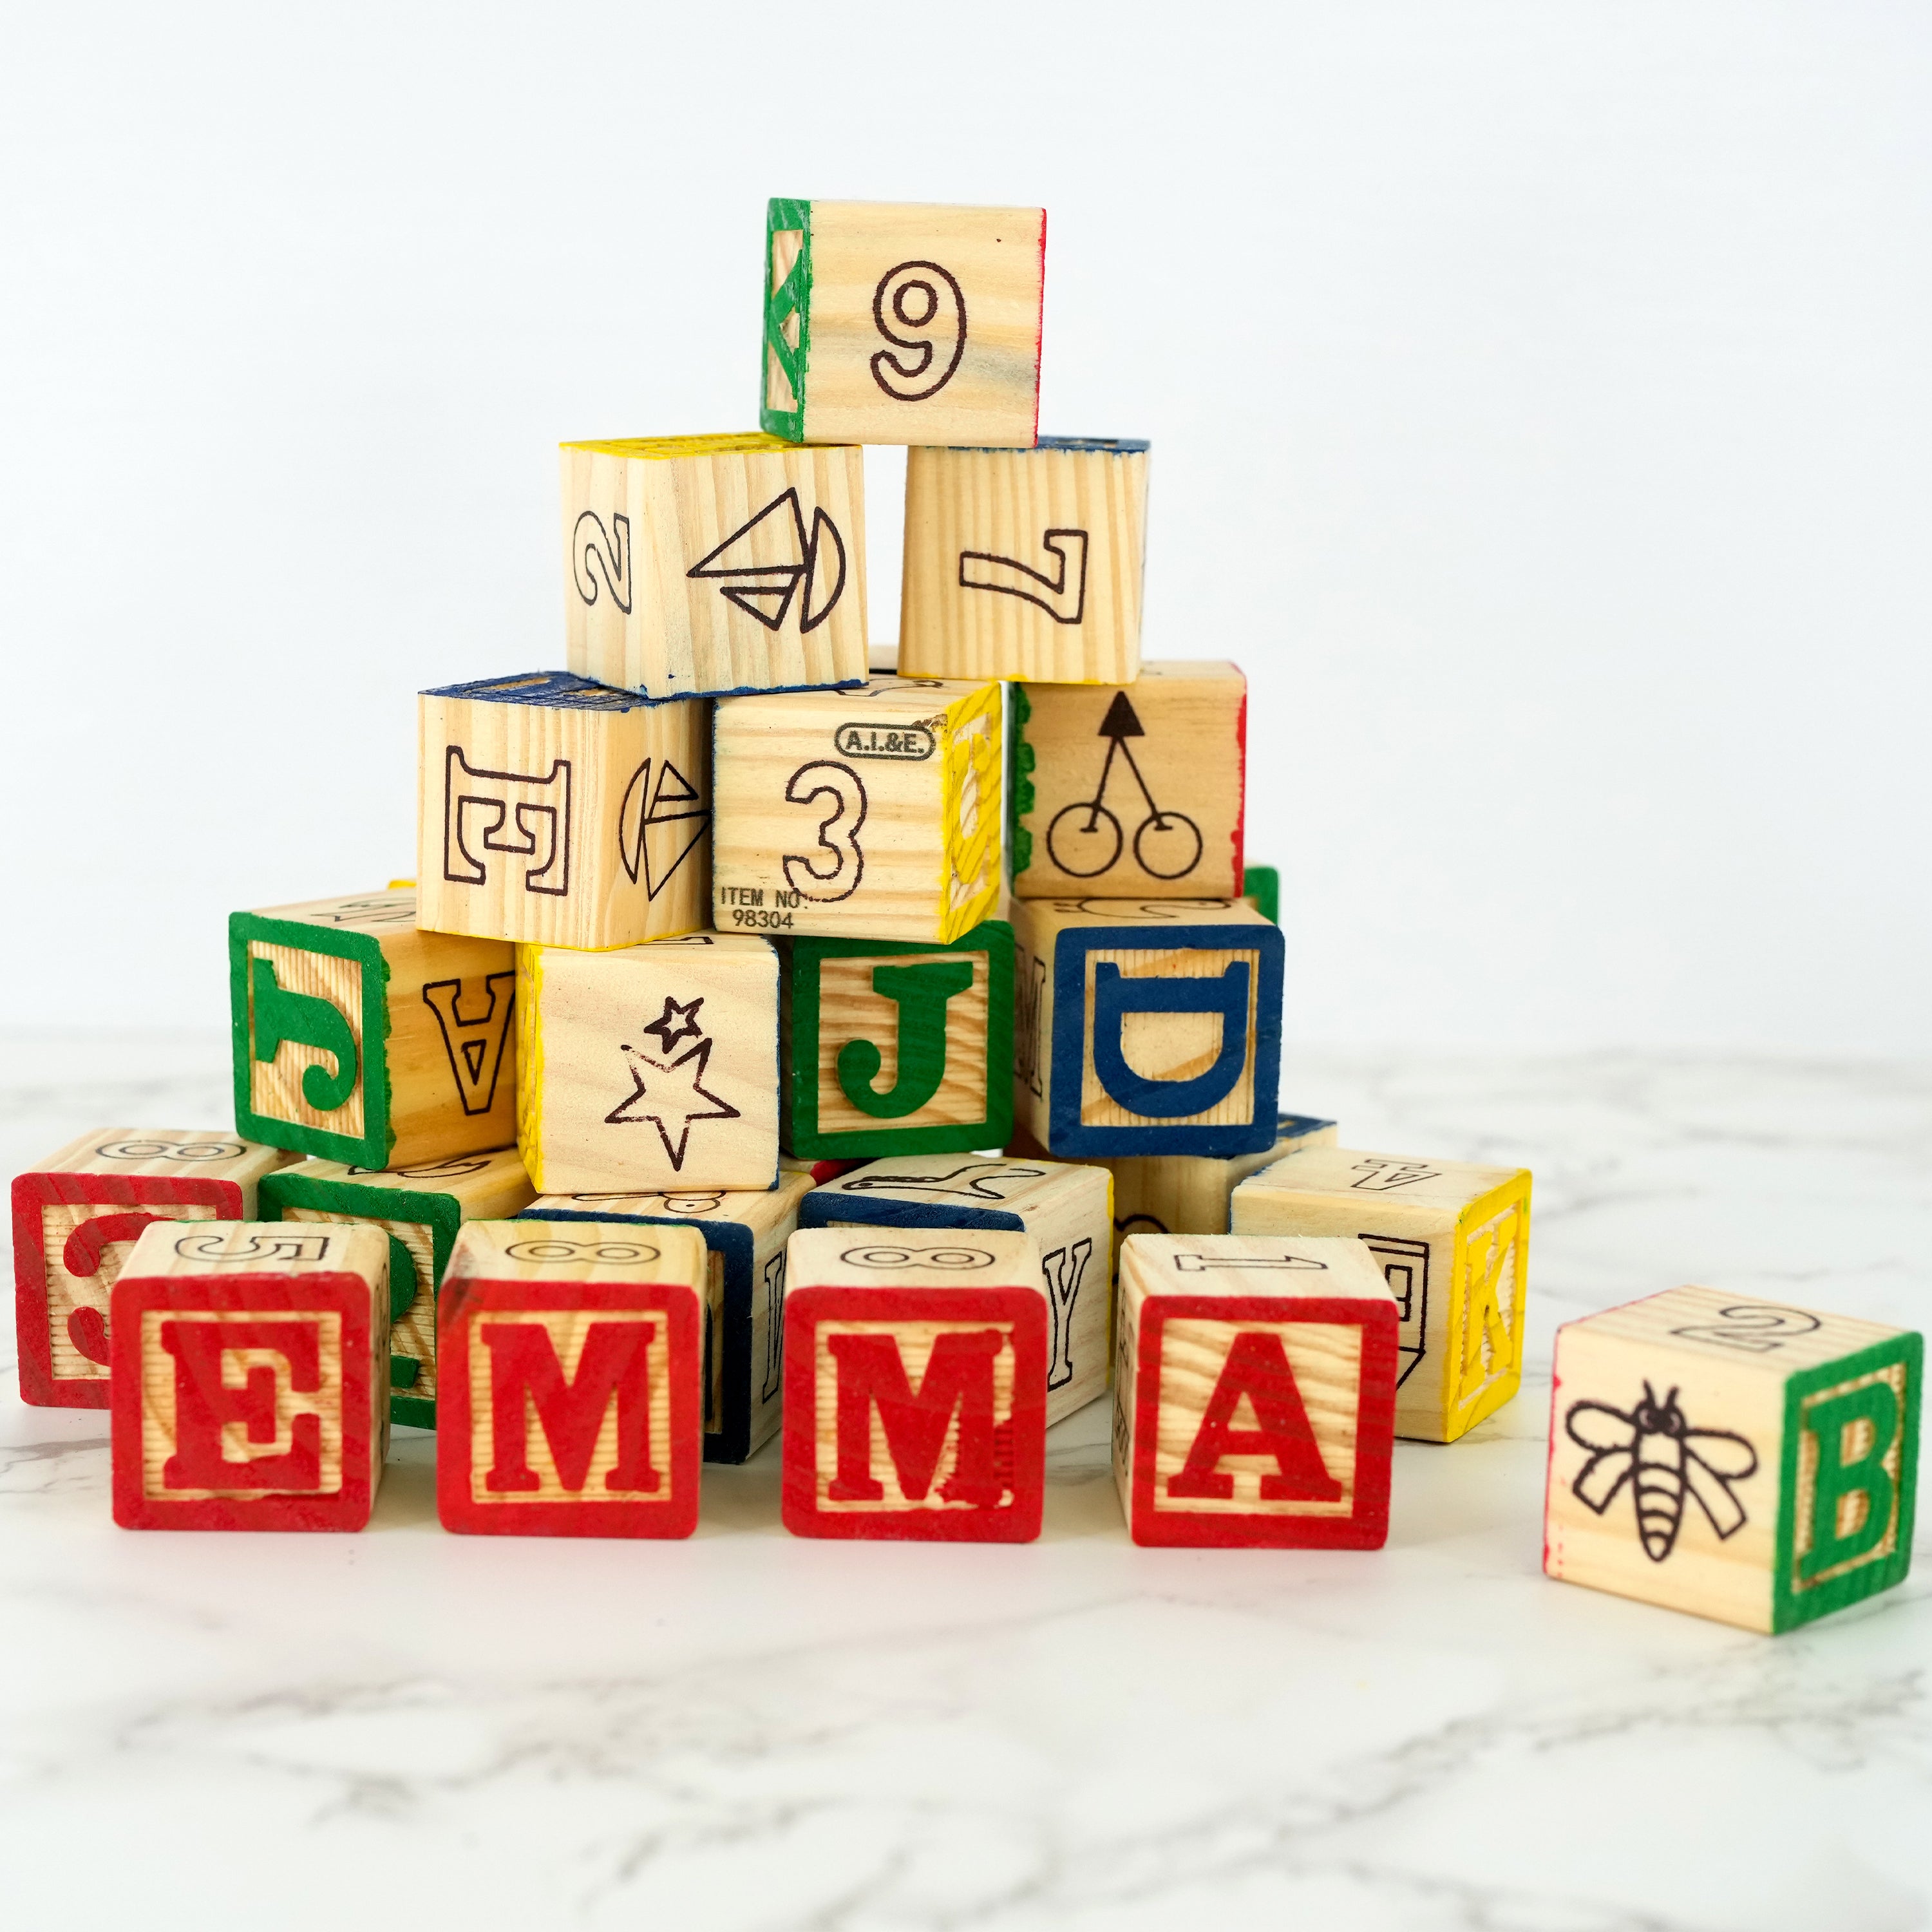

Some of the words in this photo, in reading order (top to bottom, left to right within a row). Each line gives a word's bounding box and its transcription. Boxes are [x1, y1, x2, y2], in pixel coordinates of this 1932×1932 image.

[871, 260, 966, 401] 9
[573, 511, 632, 614] 2
[960, 529, 1088, 624] 7
[846, 730, 925, 754] A.I.&E.
[444, 745, 571, 897] E
[783, 760, 867, 903] 3
[721, 887, 764, 907] ITEM
[733, 909, 793, 929] 98304
[254, 958, 357, 1111] J
[422, 970, 517, 1115] A
[837, 961, 973, 1119] J
[1094, 961, 1250, 1118] D
[96, 1140, 247, 1161] 8
[1350, 1159, 1443, 1191] 4
[175, 1235, 330, 1261] 5
[505, 1240, 661, 1265] 8
[840, 1246, 995, 1270] 8
[1459, 1211, 1519, 1405] K
[1042, 1238, 1092, 1392] Y
[1669, 1305, 1821, 1352] 2
[160, 1320, 321, 1490] E
[481, 1321, 656, 1493] M
[828, 1328, 1003, 1507] M
[1167, 1332, 1341, 1503] A
[1799, 1381, 1904, 1582] B
